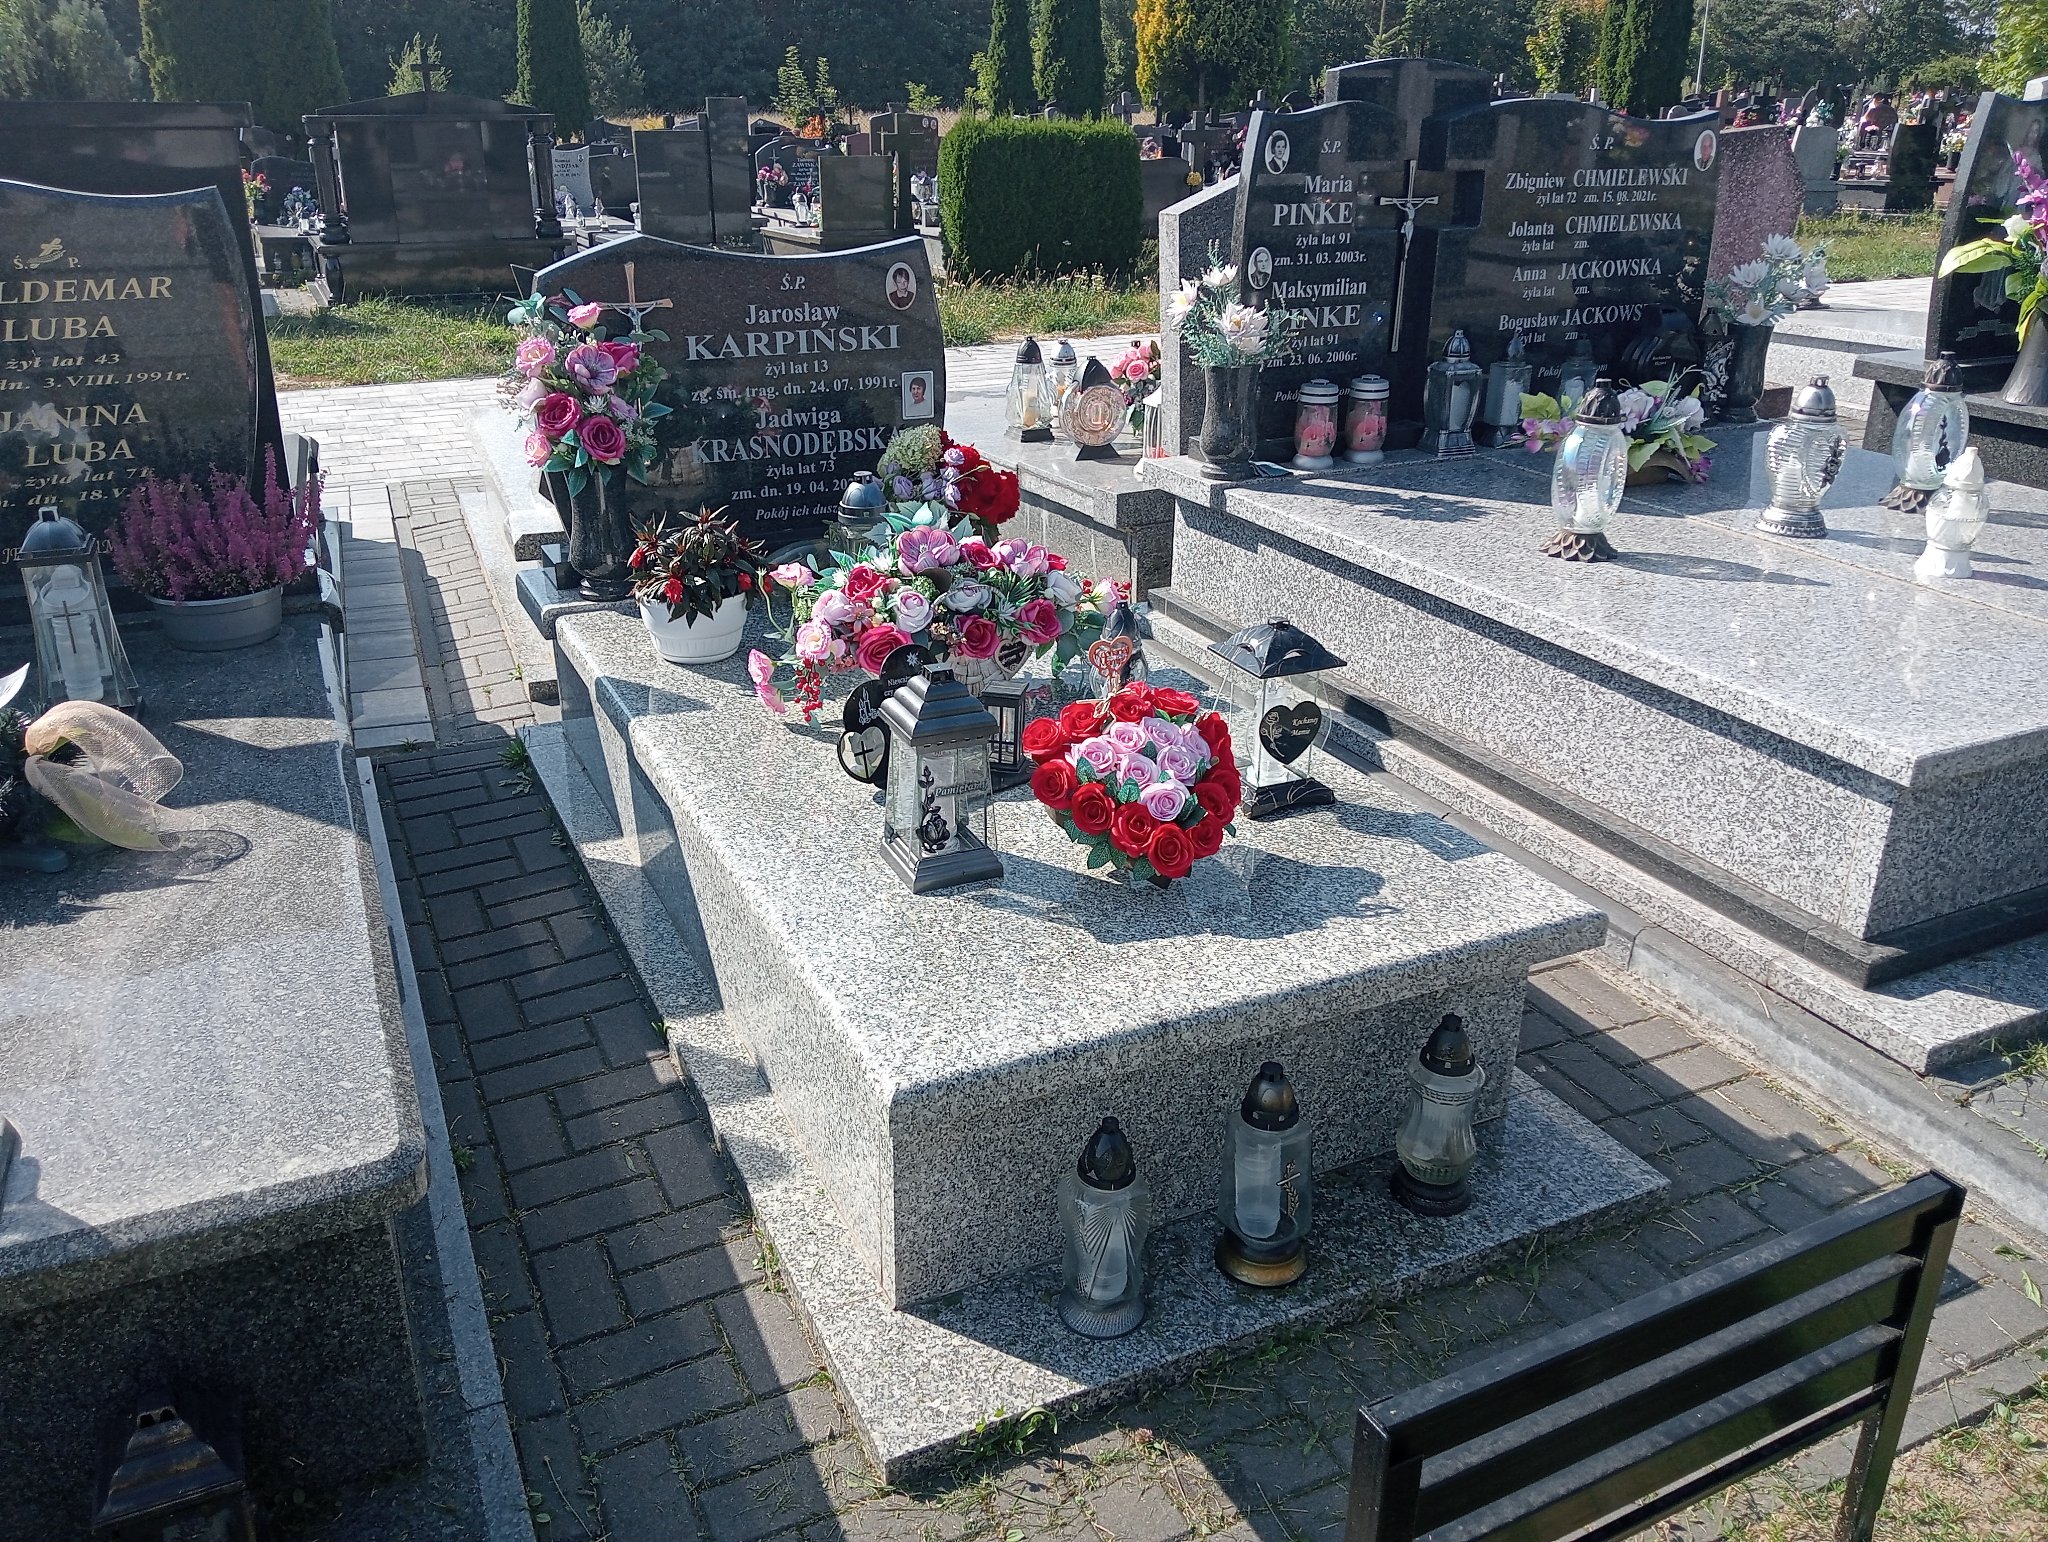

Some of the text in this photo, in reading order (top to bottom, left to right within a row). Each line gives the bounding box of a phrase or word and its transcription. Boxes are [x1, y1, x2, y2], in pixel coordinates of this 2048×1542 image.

[1304, 174, 1353, 193] Maria
[1505, 168, 1688, 193] Zbigniew CHMIELEWSKI
[1536, 191, 1657, 205] żył lat 72 zm. 15. 08. 2021r.
[1272, 202, 1353, 227] PINKE
[1508, 213, 1682, 238] Jolanta CHMIELEWSKA
[1296, 232, 1350, 247] żyła lat 91
[1542, 240, 1554, 250] lat
[1574, 240, 1590, 249] zm.
[1274, 251, 1367, 266] zm. 31. 03. 2003r.
[1512, 258, 1662, 282] Anna JACKOWSKA
[1271, 279, 1367, 302] Maksymilian
[1542, 286, 1555, 297] lat
[1574, 285, 1590, 295] zm.
[745, 302, 840, 325] Jarosław
[1499, 313, 1559, 334] Bogusław
[2, 315, 118, 342] LUBA
[1533, 332, 1545, 343] lat
[685, 321, 901, 361] KARPIŃSKI
[1291, 333, 1338, 350] żył lat 91
[5, 354, 120, 371] żył lat 43
[765, 360, 829, 378] żył lat 13
[1267, 350, 1358, 368] zm. 23. 06. 2006r.
[691, 388, 712, 404] zg.
[745, 384, 779, 402] trag.
[783, 380, 805, 395] dn.
[809, 381, 829, 393] 24.
[833, 379, 853, 392] 07.
[858, 375, 898, 390] 1991r.
[0, 402, 150, 433] JANINA
[756, 407, 841, 431] Jadwiga
[25, 439, 136, 467] LUBA
[25, 472, 72, 489] żyła
[84, 469, 115, 482] lat
[766, 460, 835, 480] żyła lat 73
[27, 494, 65, 507] dn.
[731, 488, 757, 500] zm.
[760, 484, 783, 498] dn.
[787, 482, 806, 495] 19.
[809, 481, 829, 494] 04.
[755, 507, 789, 521] Pokój
[792, 504, 810, 518] ich
